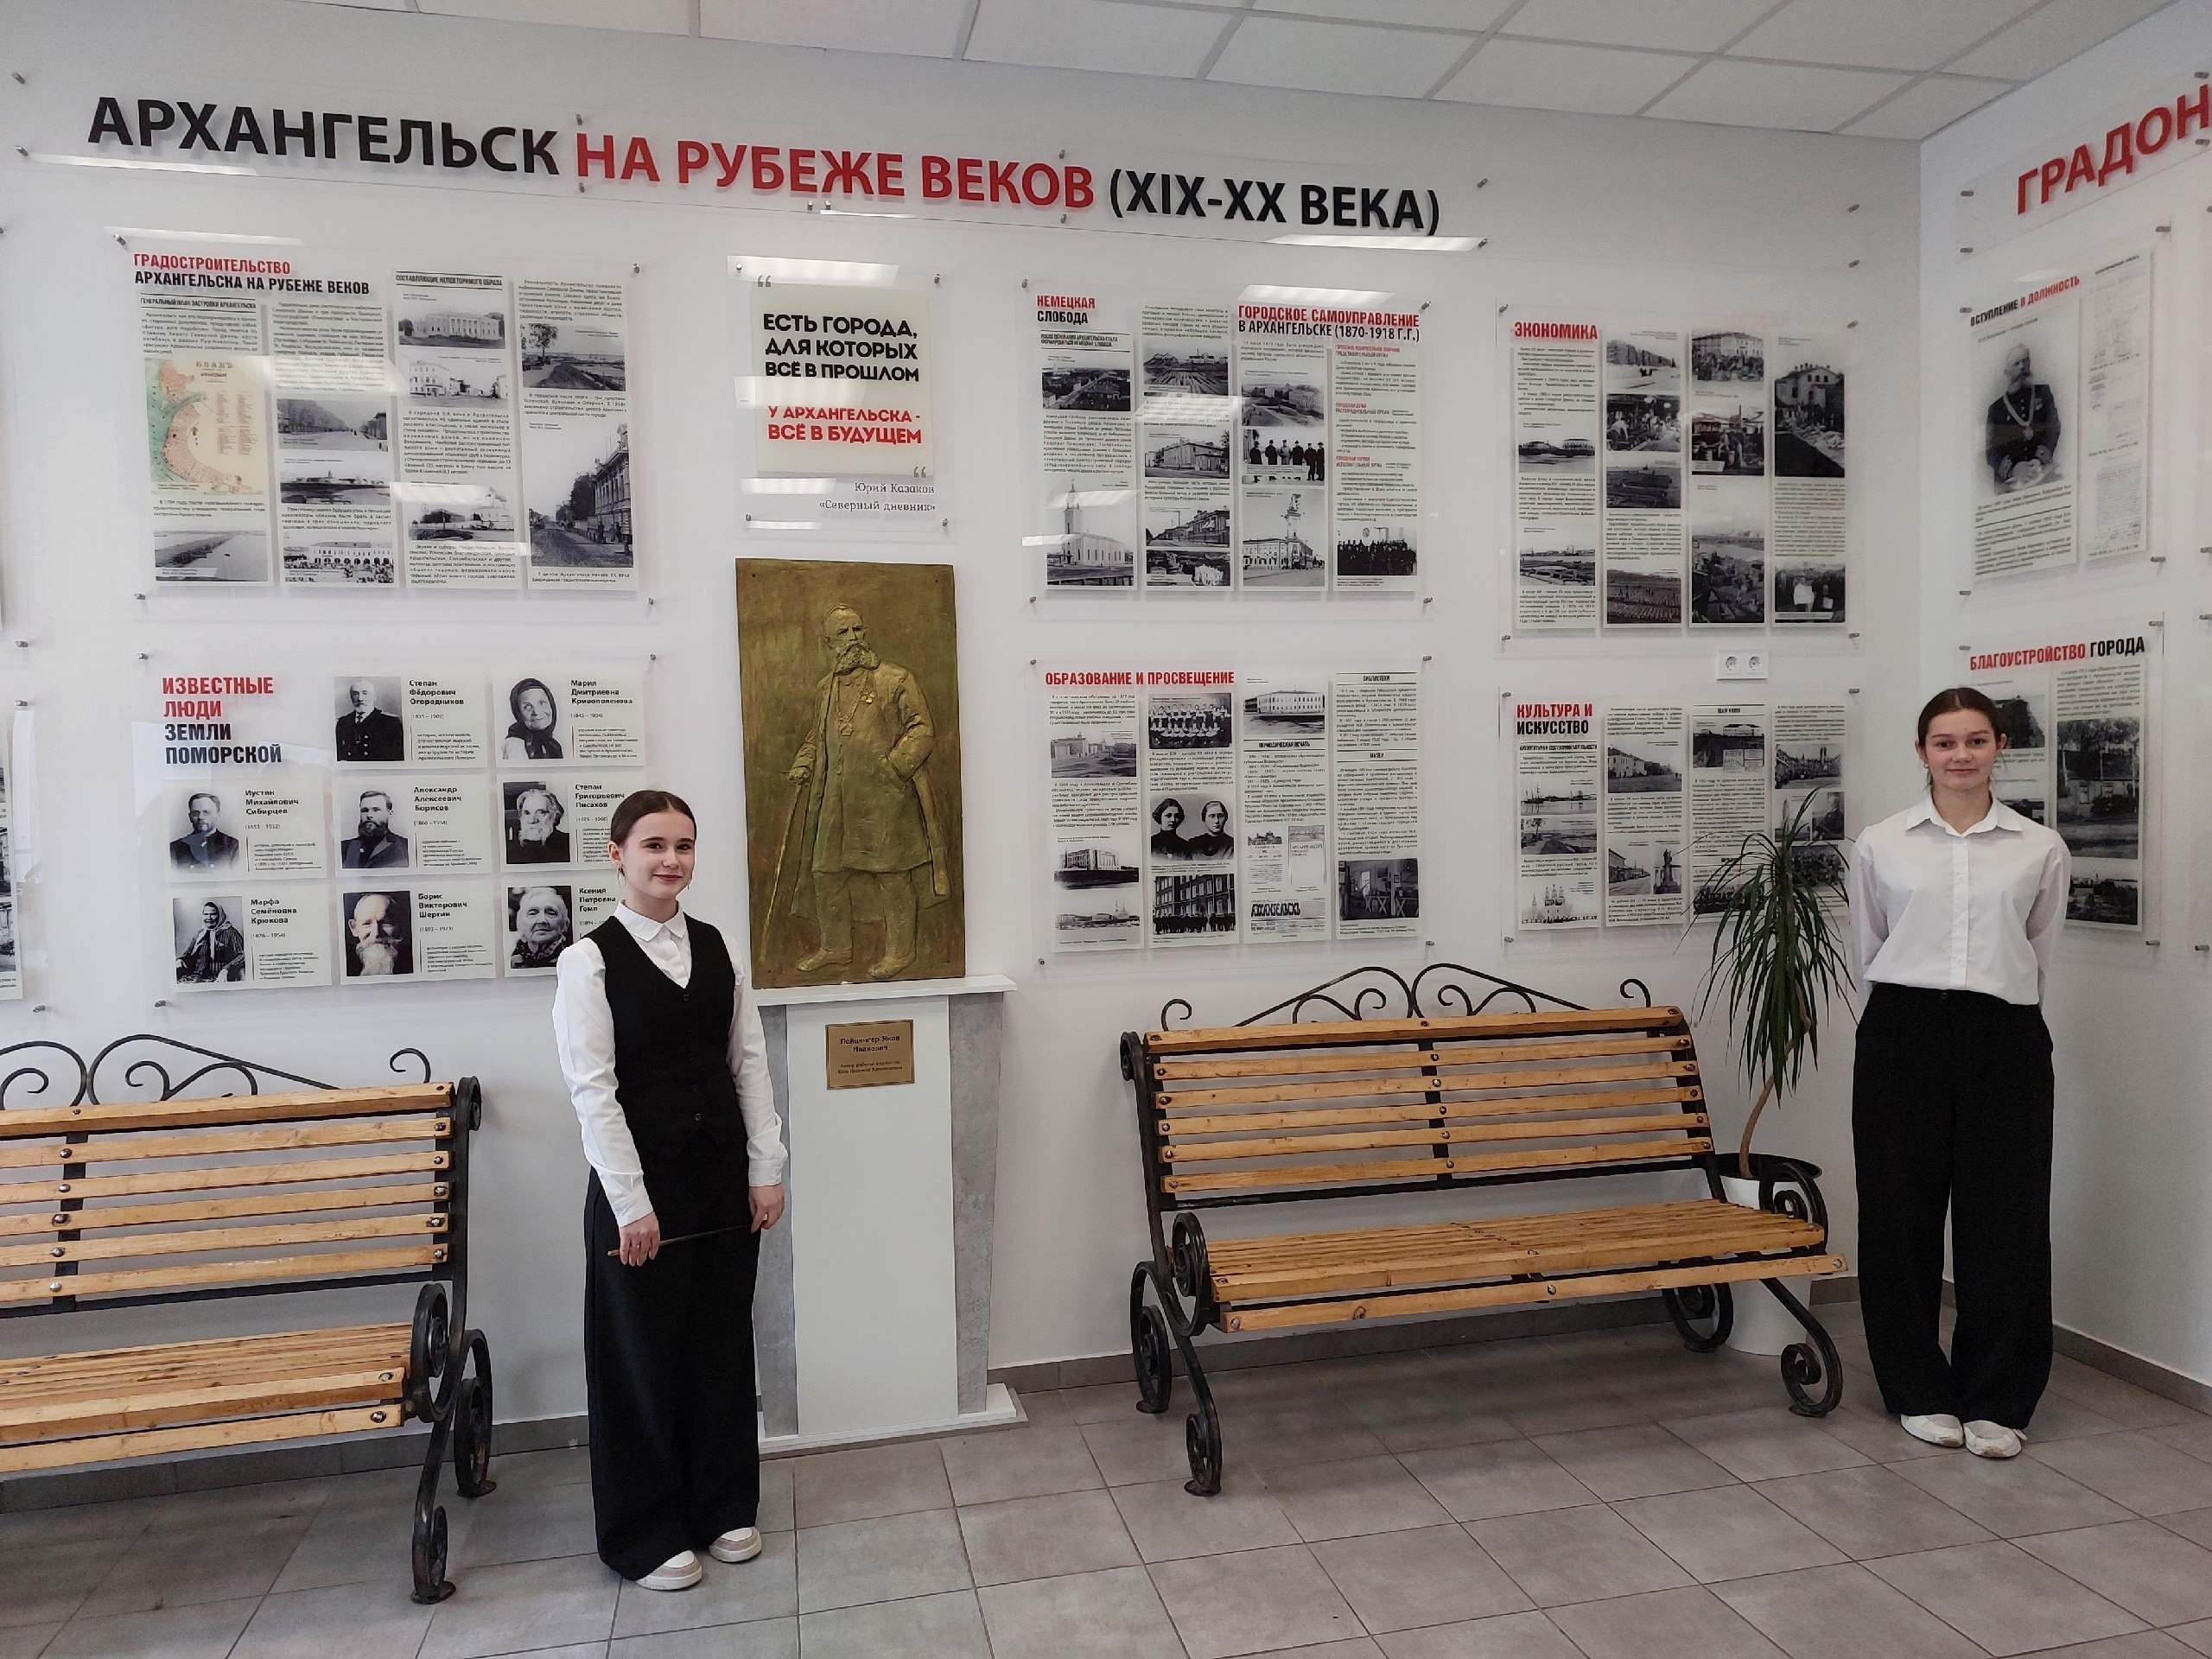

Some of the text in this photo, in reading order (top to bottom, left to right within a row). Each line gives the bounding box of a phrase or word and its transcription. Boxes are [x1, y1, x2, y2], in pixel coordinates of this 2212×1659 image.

[2018, 84, 2209, 214] ГРАДОН
[88, 96, 1440, 236] АРХАНГЕЛЬСК НА РУБЕЖЕ ВЕКОВ (XIX-XX ВЕКА)
[134, 253, 290, 275] ГРАДОСТРОИТЕЛЬСТВО
[135, 270, 370, 295] АРХАНГЕЛЬСКА НА РУБЕЖЕ ВЕКОВ
[396, 274, 439, 283] СОСТАВЛЯЮЩИЕ
[439, 276, 482, 285] НЕПОВТОРИМОГО
[1037, 295, 1096, 309] НЕМЕЦКАЯ
[1970, 276, 2080, 327] ВСТУПЛЕНИЕ В ДОЛЖНОСТЬ
[1037, 310, 1089, 325] СЛОБОДА
[1238, 305, 1420, 327] ГОРОДСКОЕ САМОУПРАВЛЕНИЕ
[764, 314, 918, 339] ЕСТЬ ГОРОДА,
[1239, 321, 1246, 333] В
[1249, 321, 1332, 336] АРХАНГЕЛЬСКЕ
[1335, 325, 1395, 340] (1870-1918
[1397, 329, 1421, 343] Г.Г.)
[1514, 321, 1598, 340] ЭКОНОМИКА
[765, 338, 918, 360] ДЛЯ КОТОРЫХ
[765, 361, 919, 382] ВСЁ В ПРОШЛОМ
[767, 405, 779, 418] У
[783, 406, 912, 423] АРХАНГЕЛЬСКА
[767, 423, 922, 445] ВСЁ В БУДУЩЕМ
[855, 482, 935, 494] Юрий Казаков
[819, 500, 936, 512] «Северный дневник»
[1970, 636, 2145, 671] БЛАГОУСТРОЙСТВО ГОРОДА
[162, 677, 274, 695] ИЗВЕСТНЫЕ
[409, 679, 437, 688] Степан
[570, 679, 597, 688] Мария
[1045, 671, 1235, 687] ОБРАЗОВАНИЕ И ПРОСВЕЩЕНИЕ
[410, 689, 456, 697] Фёдорович
[570, 688, 620, 697] Дмитриевна
[410, 697, 465, 706] Огородников
[162, 700, 222, 720] ЛЮДИ
[1516, 703, 1592, 719] КУЛЬТУРА И
[164, 723, 232, 741] ЗЕМЛИ
[1516, 720, 1589, 735] ИСКУССТВО
[165, 744, 282, 765] ПОМОРСКОЙ
[413, 785, 458, 794] Александр
[575, 783, 602, 791] Степан
[245, 798, 299, 806] Михайлович
[414, 794, 461, 803] Алексеевич
[245, 807, 289, 817] Сибирцев
[415, 804, 448, 812] Борисов
[250, 898, 280, 907] Марфа
[418, 900, 467, 910] Викторович
[251, 906, 297, 915] Семёновна
[419, 910, 450, 918] Шергин
[251, 916, 289, 925] Крюкова
